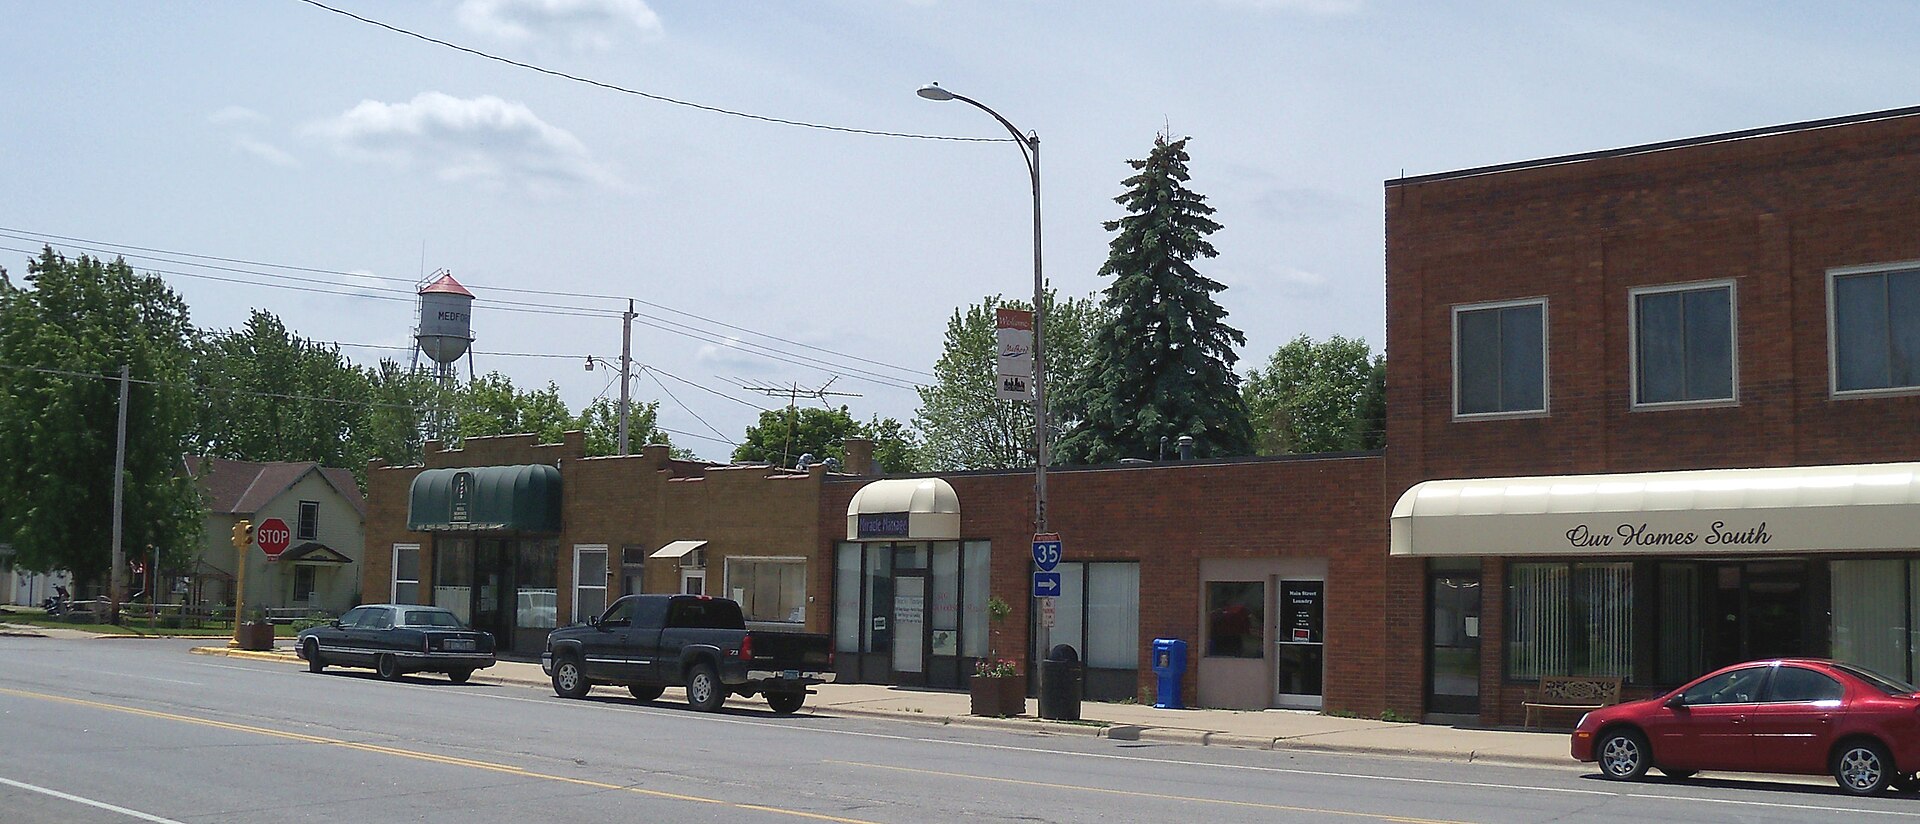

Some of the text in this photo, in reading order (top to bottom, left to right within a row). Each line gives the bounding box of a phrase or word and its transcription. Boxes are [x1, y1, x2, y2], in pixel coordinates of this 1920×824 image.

[259, 529, 289, 543] STOP
[1566, 521, 1773, 547] Our Homes South
[1037, 544, 1058, 564] 35
